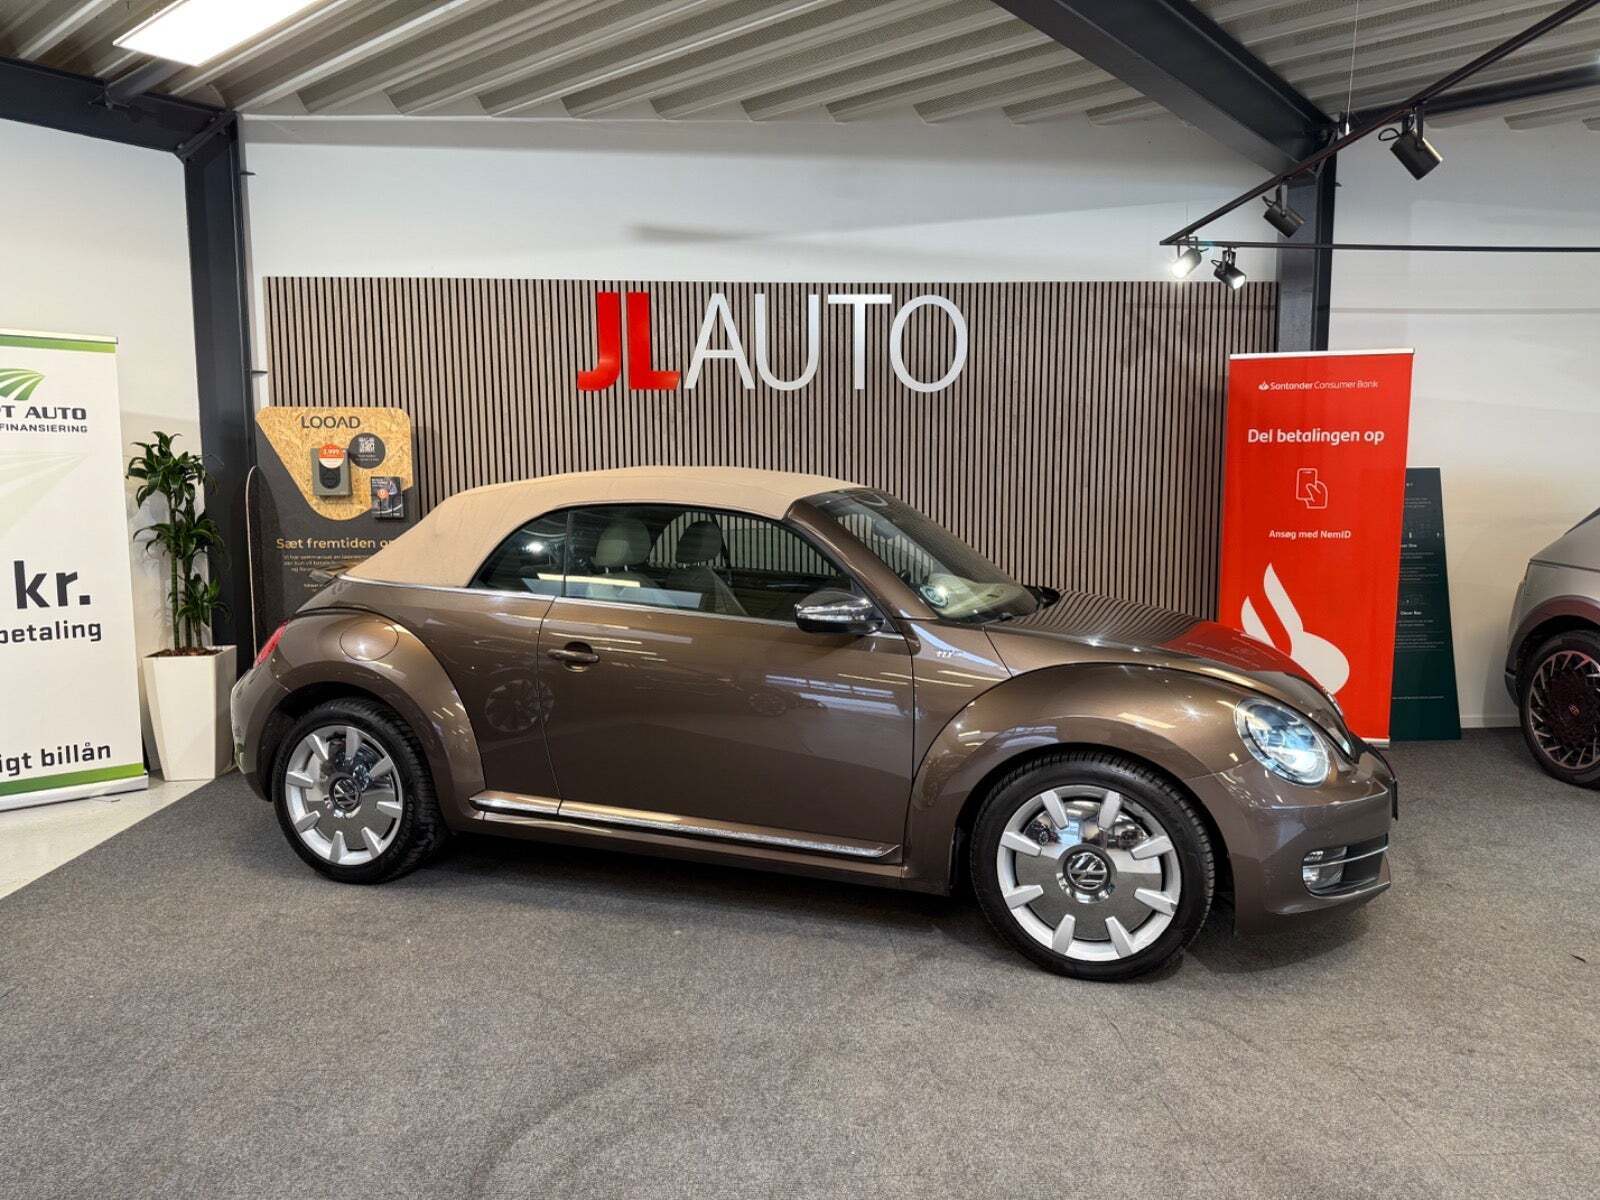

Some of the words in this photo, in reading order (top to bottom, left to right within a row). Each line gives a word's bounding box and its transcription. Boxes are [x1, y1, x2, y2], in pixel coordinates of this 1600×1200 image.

[577, 292, 680, 391] JL
[684, 292, 968, 393] AUTO
[1270, 381, 1313, 391] Santander
[1313, 380, 1356, 390] Consumer
[1357, 379, 1379, 389] Bank
[0, 405, 15, 418] T
[24, 406, 87, 420] AUTO
[301, 415, 361, 429] LOOAD
[1247, 429, 1273, 443] Del
[1277, 427, 1360, 446] betalingen
[1364, 430, 1385, 445] op
[1269, 530, 1297, 540] Ansøg
[1298, 530, 1319, 538] med
[1320, 530, 1352, 539] NemID
[276, 538, 304, 549] Sæt
[307, 537, 376, 549] fremtiden
[14, 560, 91, 610] kr.
[41, 742, 111, 767] billån
